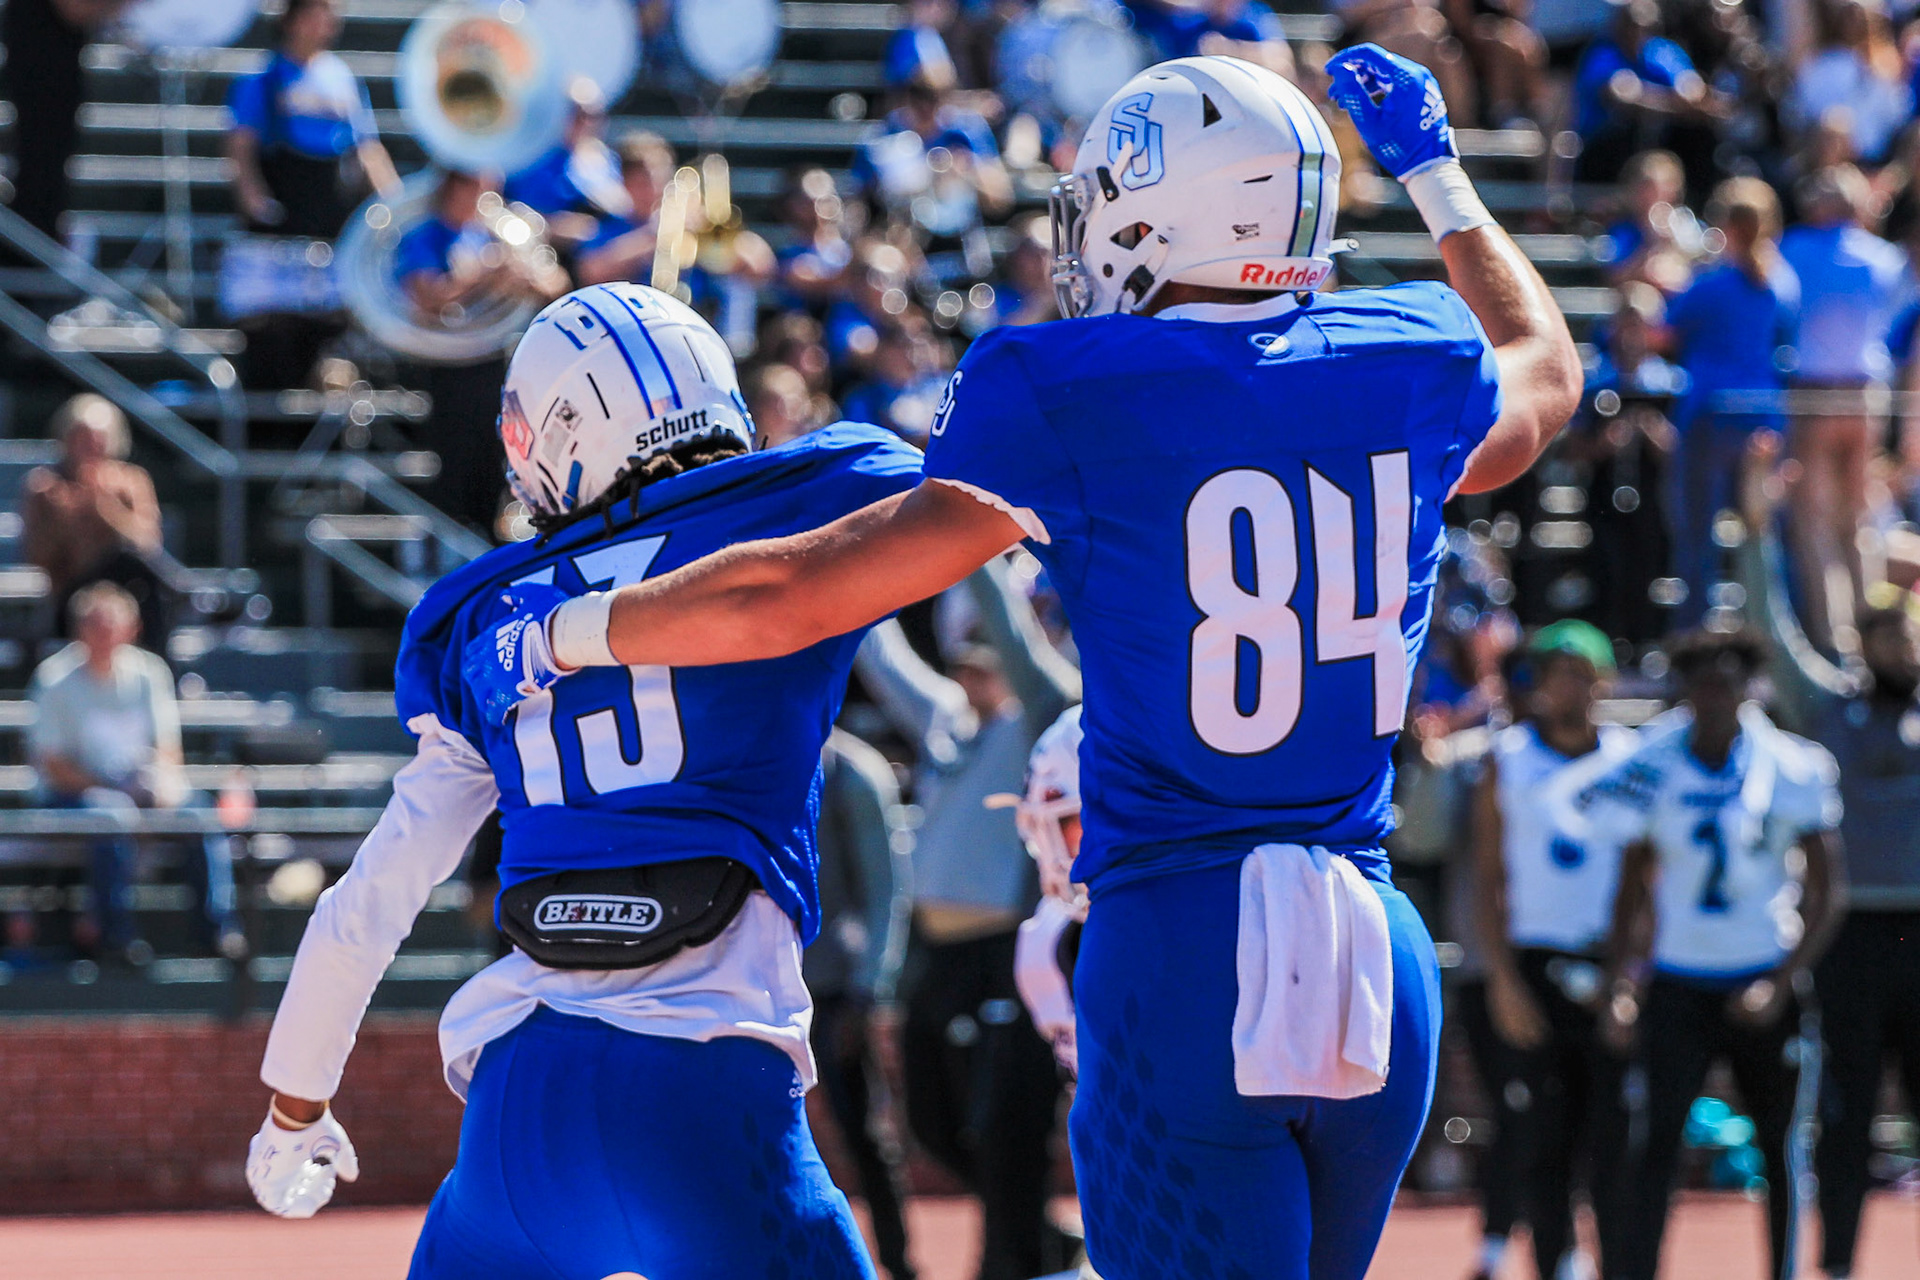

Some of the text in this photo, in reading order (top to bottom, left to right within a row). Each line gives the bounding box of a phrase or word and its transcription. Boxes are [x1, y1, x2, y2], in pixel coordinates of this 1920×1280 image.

[636, 409, 709, 452] schutt
[1184, 448, 1411, 757] 84
[503, 612, 534, 672] adidas
[543, 901, 650, 925] BATTLE
